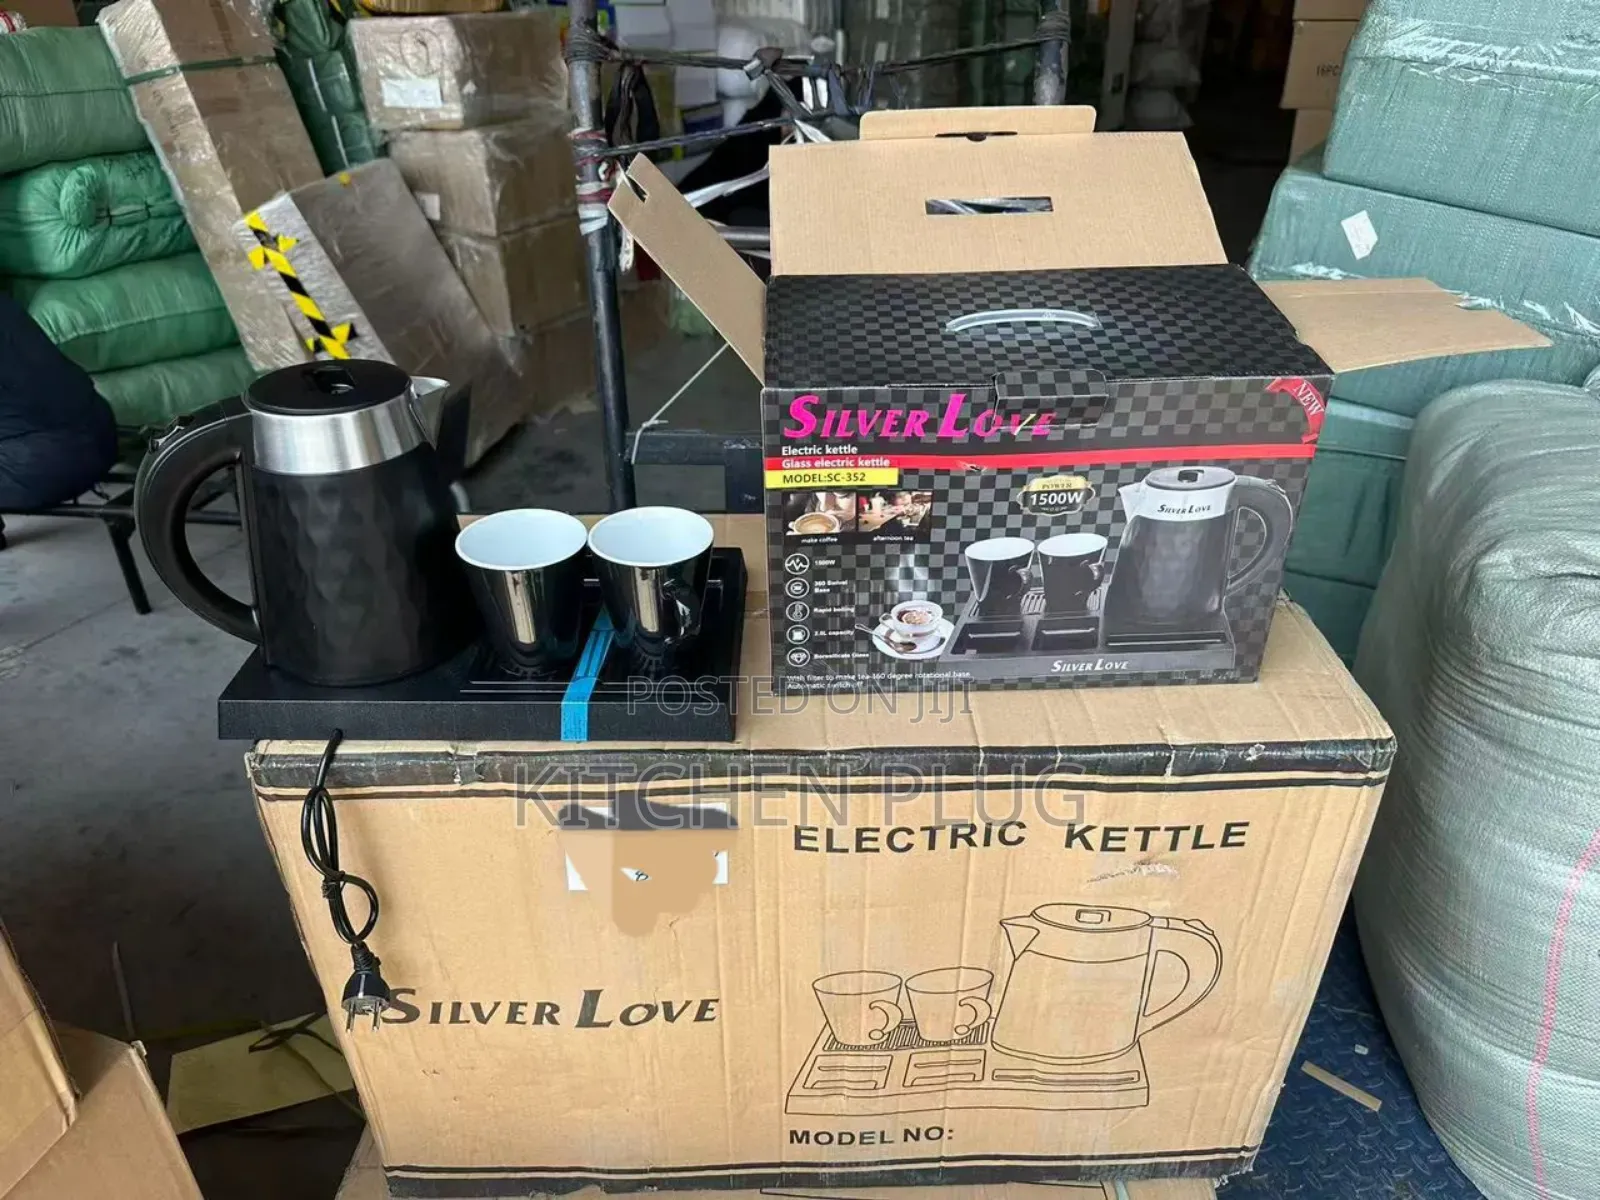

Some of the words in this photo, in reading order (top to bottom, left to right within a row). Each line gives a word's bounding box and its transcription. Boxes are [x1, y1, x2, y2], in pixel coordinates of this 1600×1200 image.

[1293, 379, 1325, 416] NEW
[783, 393, 931, 439] SILVER
[936, 393, 1058, 438] LOVE
[781, 445, 823, 456] Electric
[825, 443, 858, 455] kettle
[782, 458, 812, 469] Glass
[814, 457, 855, 468] electric
[857, 456, 891, 467] kettle
[782, 471, 866, 484] MODEL:SC-352
[1030, 491, 1085, 506] 1500W
[1157, 504, 1187, 515] SILVER
[1188, 504, 1211, 514] LOVE
[819, 535, 838, 543] coffee
[872, 534, 903, 542] afternoon
[1050, 659, 1093, 673] SILVER
[1094, 658, 1129, 671] LOVE
[887, 672, 913, 681] degree
[794, 820, 1027, 854] ELECTRIC
[1064, 820, 1250, 853] KETTLE
[380, 987, 561, 1026] SILVER
[574, 987, 720, 1029] LOVE
[789, 1129, 895, 1146] MODEL
[903, 1125, 954, 1143] NO:
